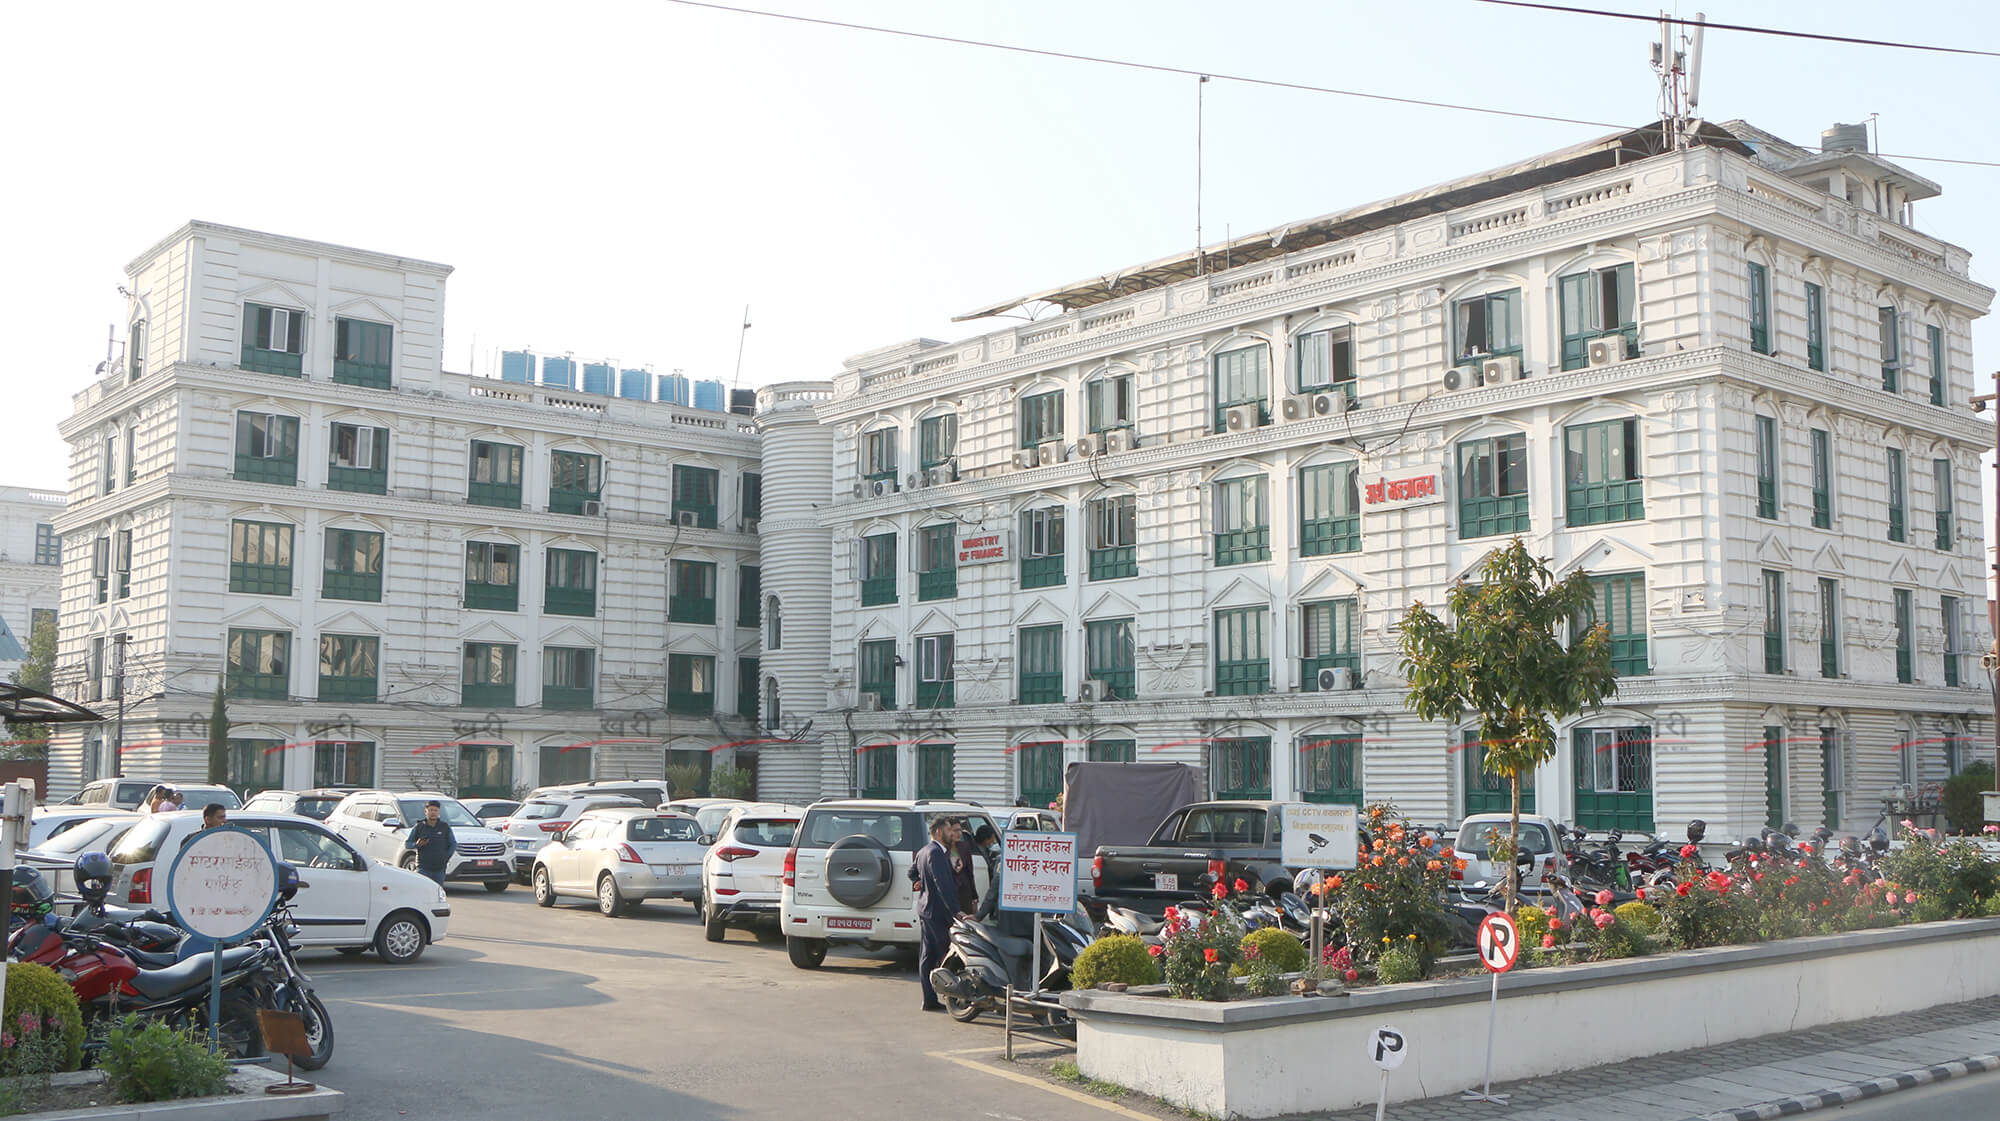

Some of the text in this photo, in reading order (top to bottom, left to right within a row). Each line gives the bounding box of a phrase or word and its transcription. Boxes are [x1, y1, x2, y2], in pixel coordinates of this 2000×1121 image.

[1302, 808, 1321, 817] CCTV
[1042, 860, 1072, 876] स्थल
[1488, 923, 1510, 961] P
[1375, 1030, 1404, 1062] P
